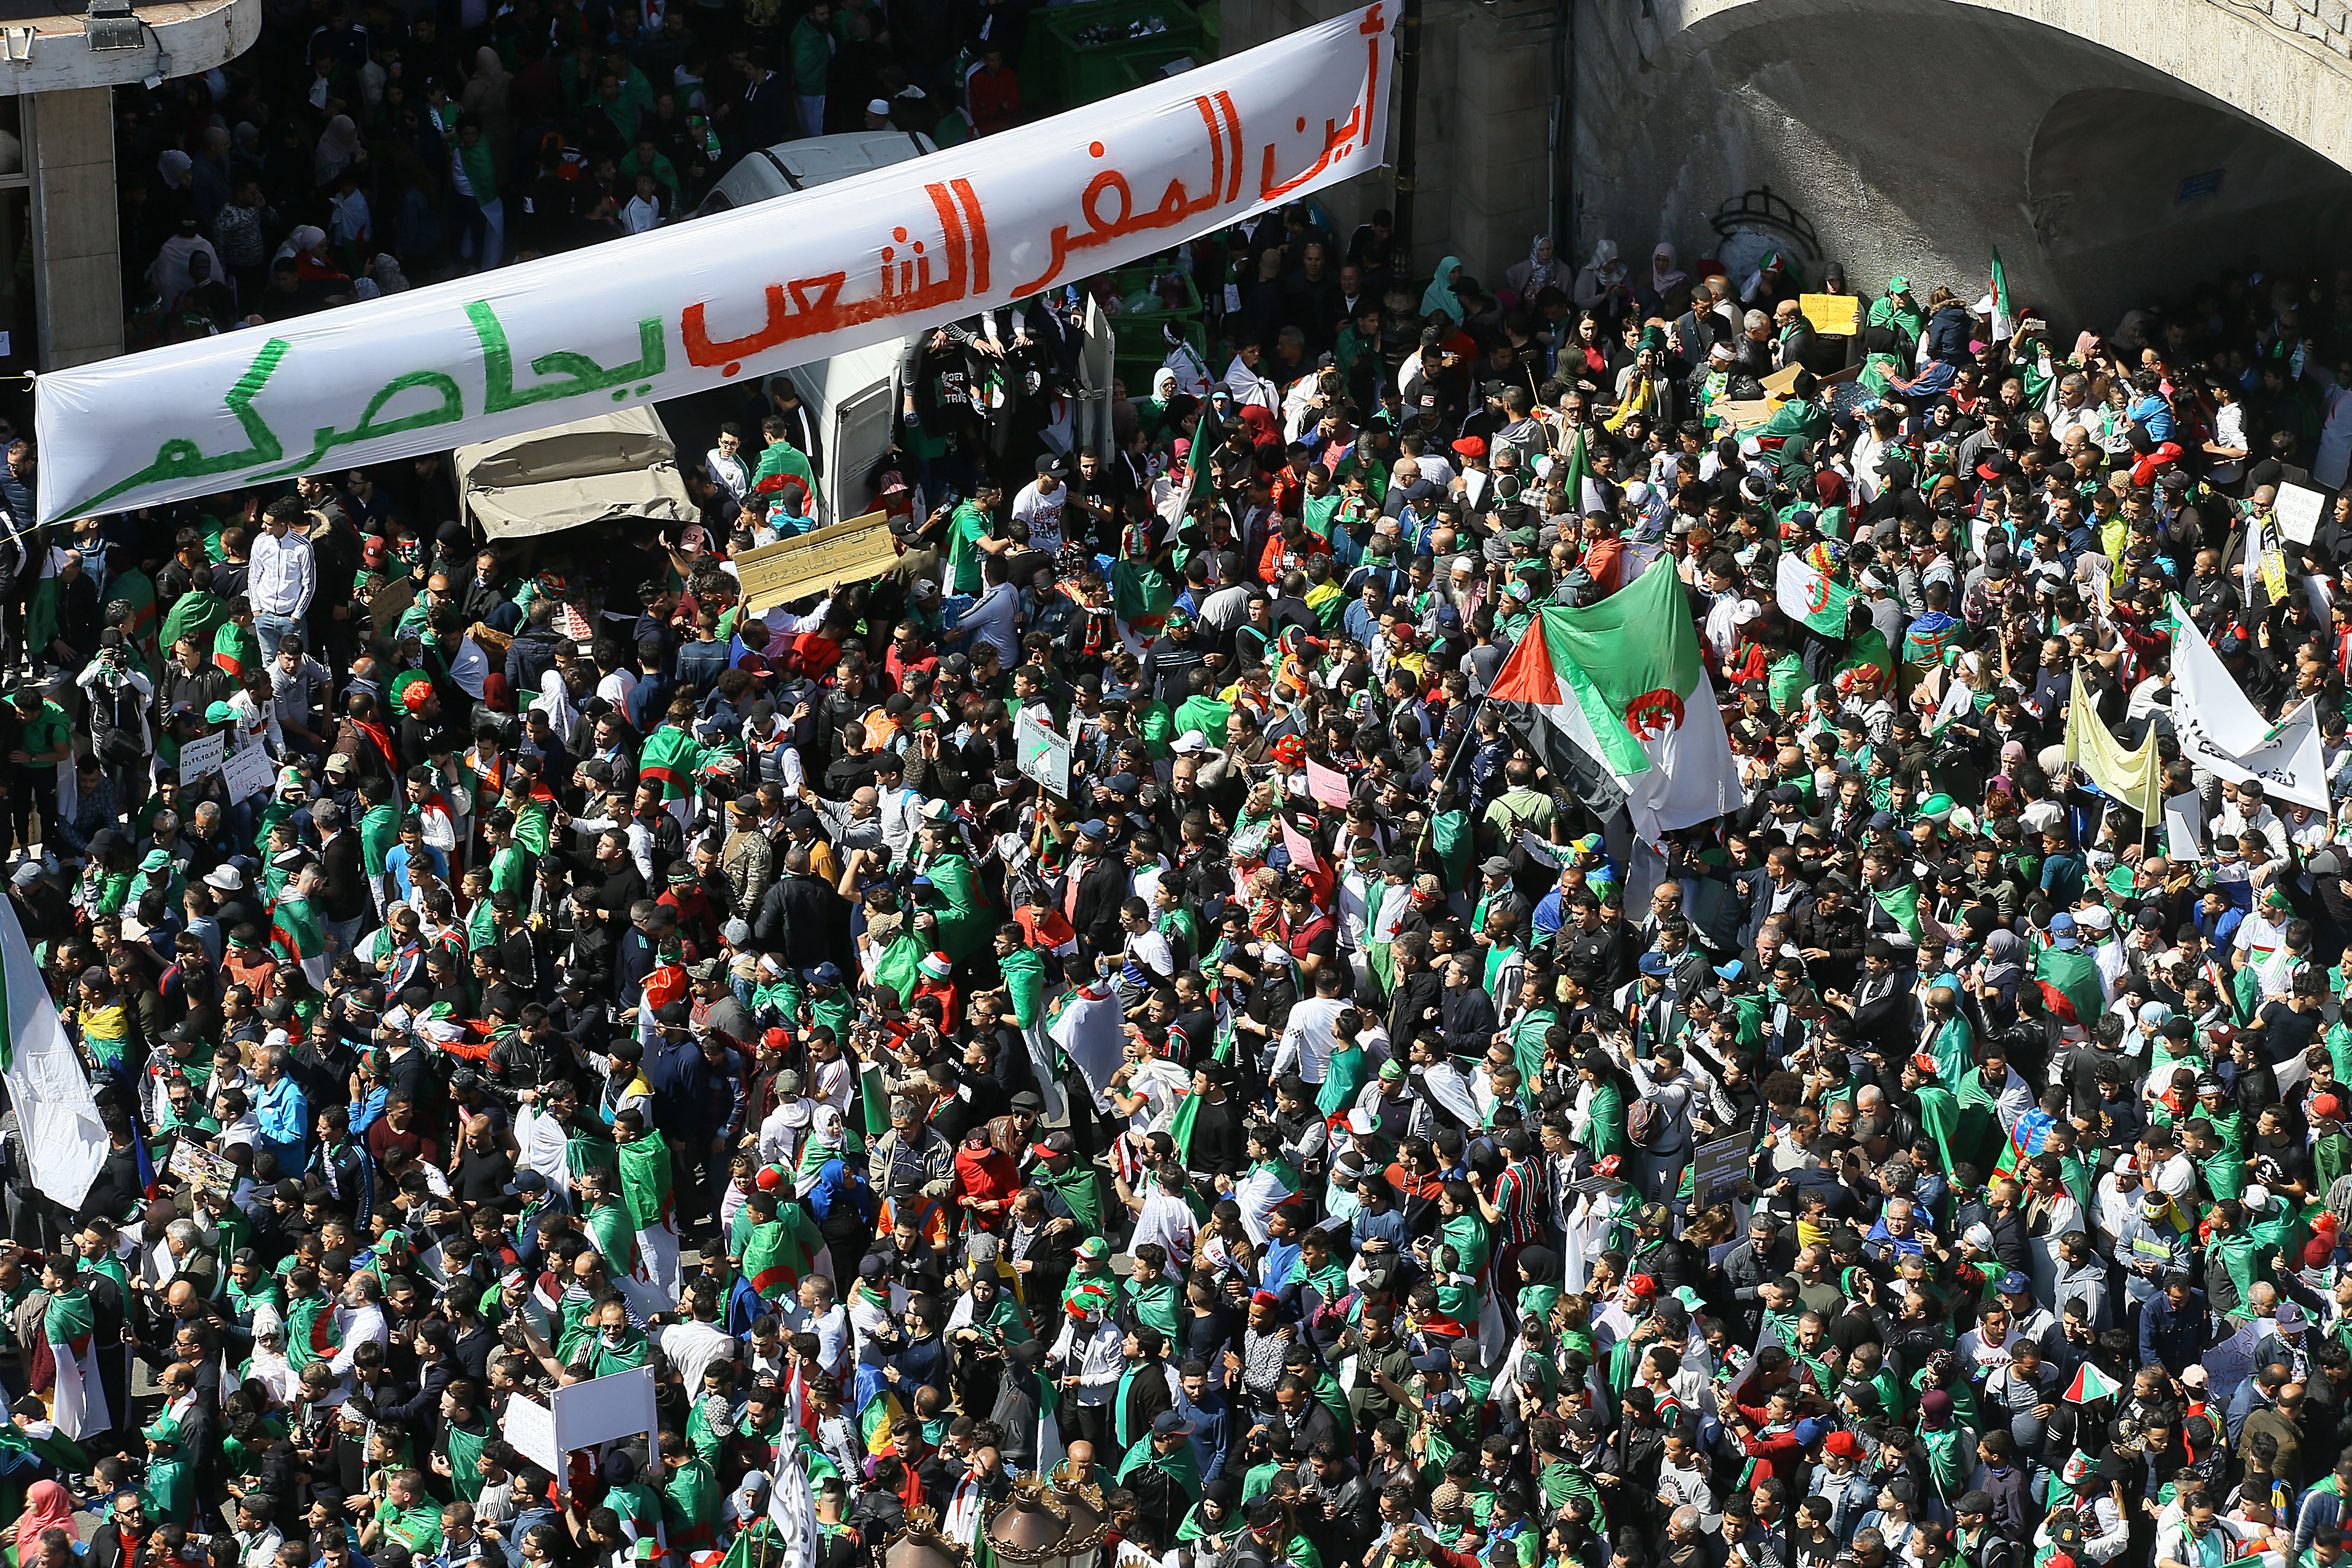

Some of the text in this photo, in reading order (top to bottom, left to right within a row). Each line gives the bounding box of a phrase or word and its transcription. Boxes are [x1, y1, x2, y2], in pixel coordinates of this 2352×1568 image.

[1259, 4, 1384, 202] أين
[1010, 90, 1243, 299] المفر
[681, 178, 990, 377] الشعب
[684, 531, 698, 541] EA7
[760, 571, 790, 585] 102
[1528, 1363, 1537, 1372] NY
